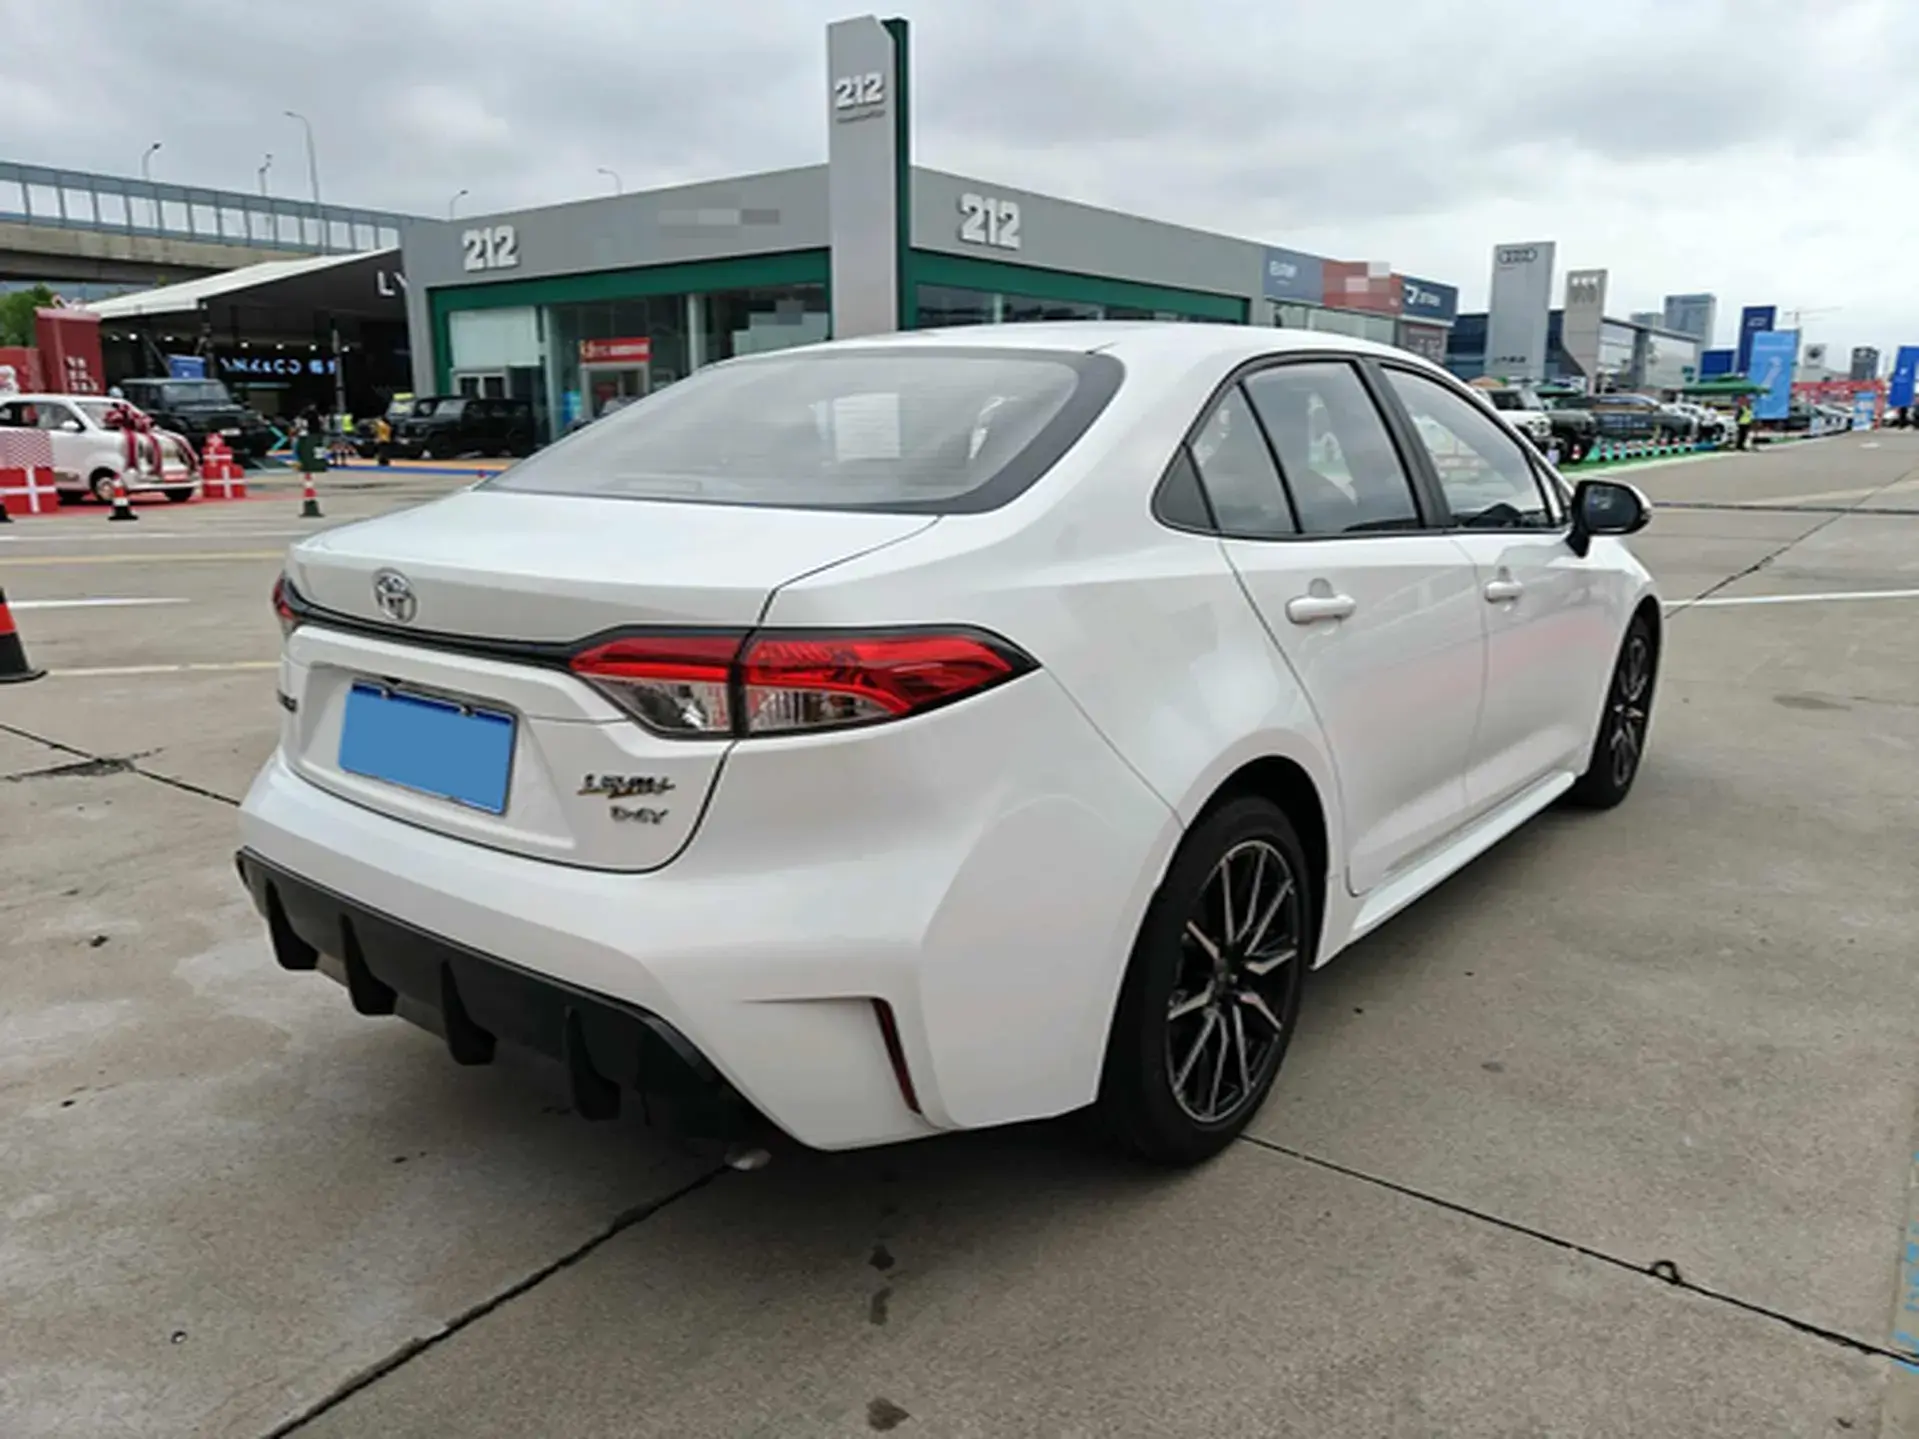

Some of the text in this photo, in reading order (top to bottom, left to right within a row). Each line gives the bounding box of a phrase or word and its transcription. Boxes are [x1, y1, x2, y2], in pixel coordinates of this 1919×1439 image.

[834, 72, 884, 109] 212
[960, 193, 1020, 249] 212
[462, 225, 518, 271] 212
